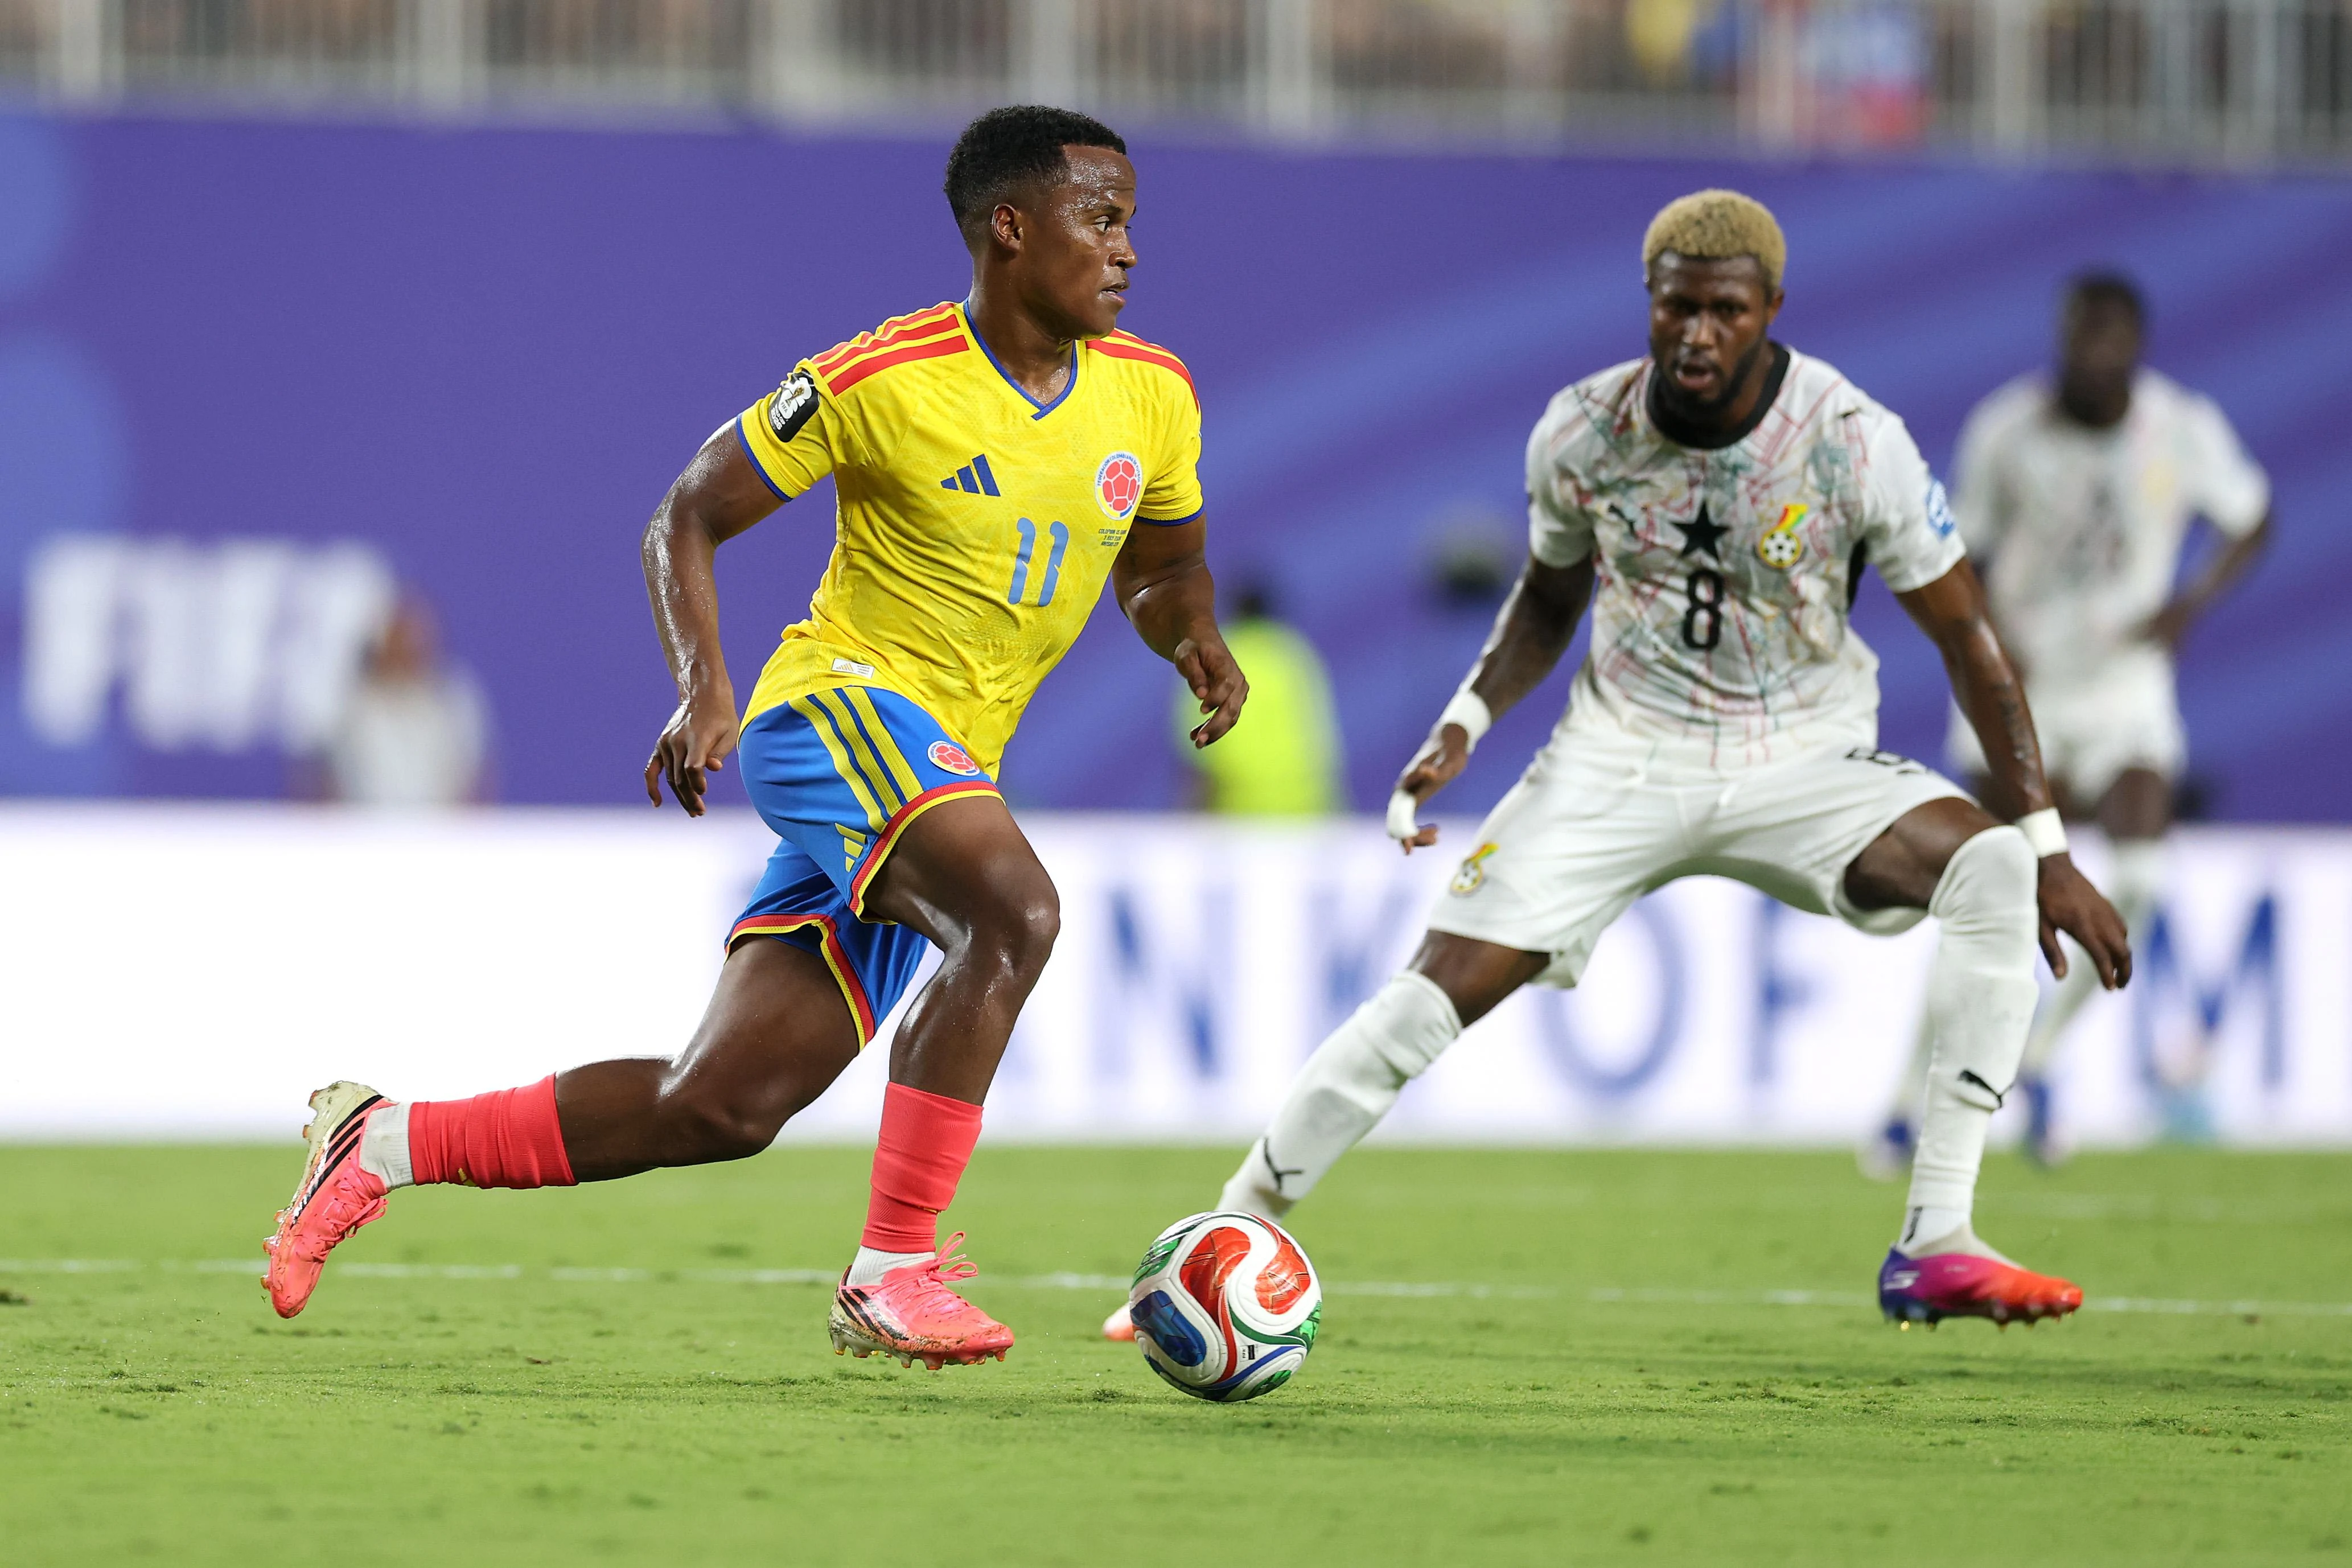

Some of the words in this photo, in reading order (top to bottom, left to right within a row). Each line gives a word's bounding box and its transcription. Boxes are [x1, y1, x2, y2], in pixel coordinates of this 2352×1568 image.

[771, 407, 783, 430] 2026
[1008, 517, 1070, 607] 11
[1683, 569, 1724, 651] 8
